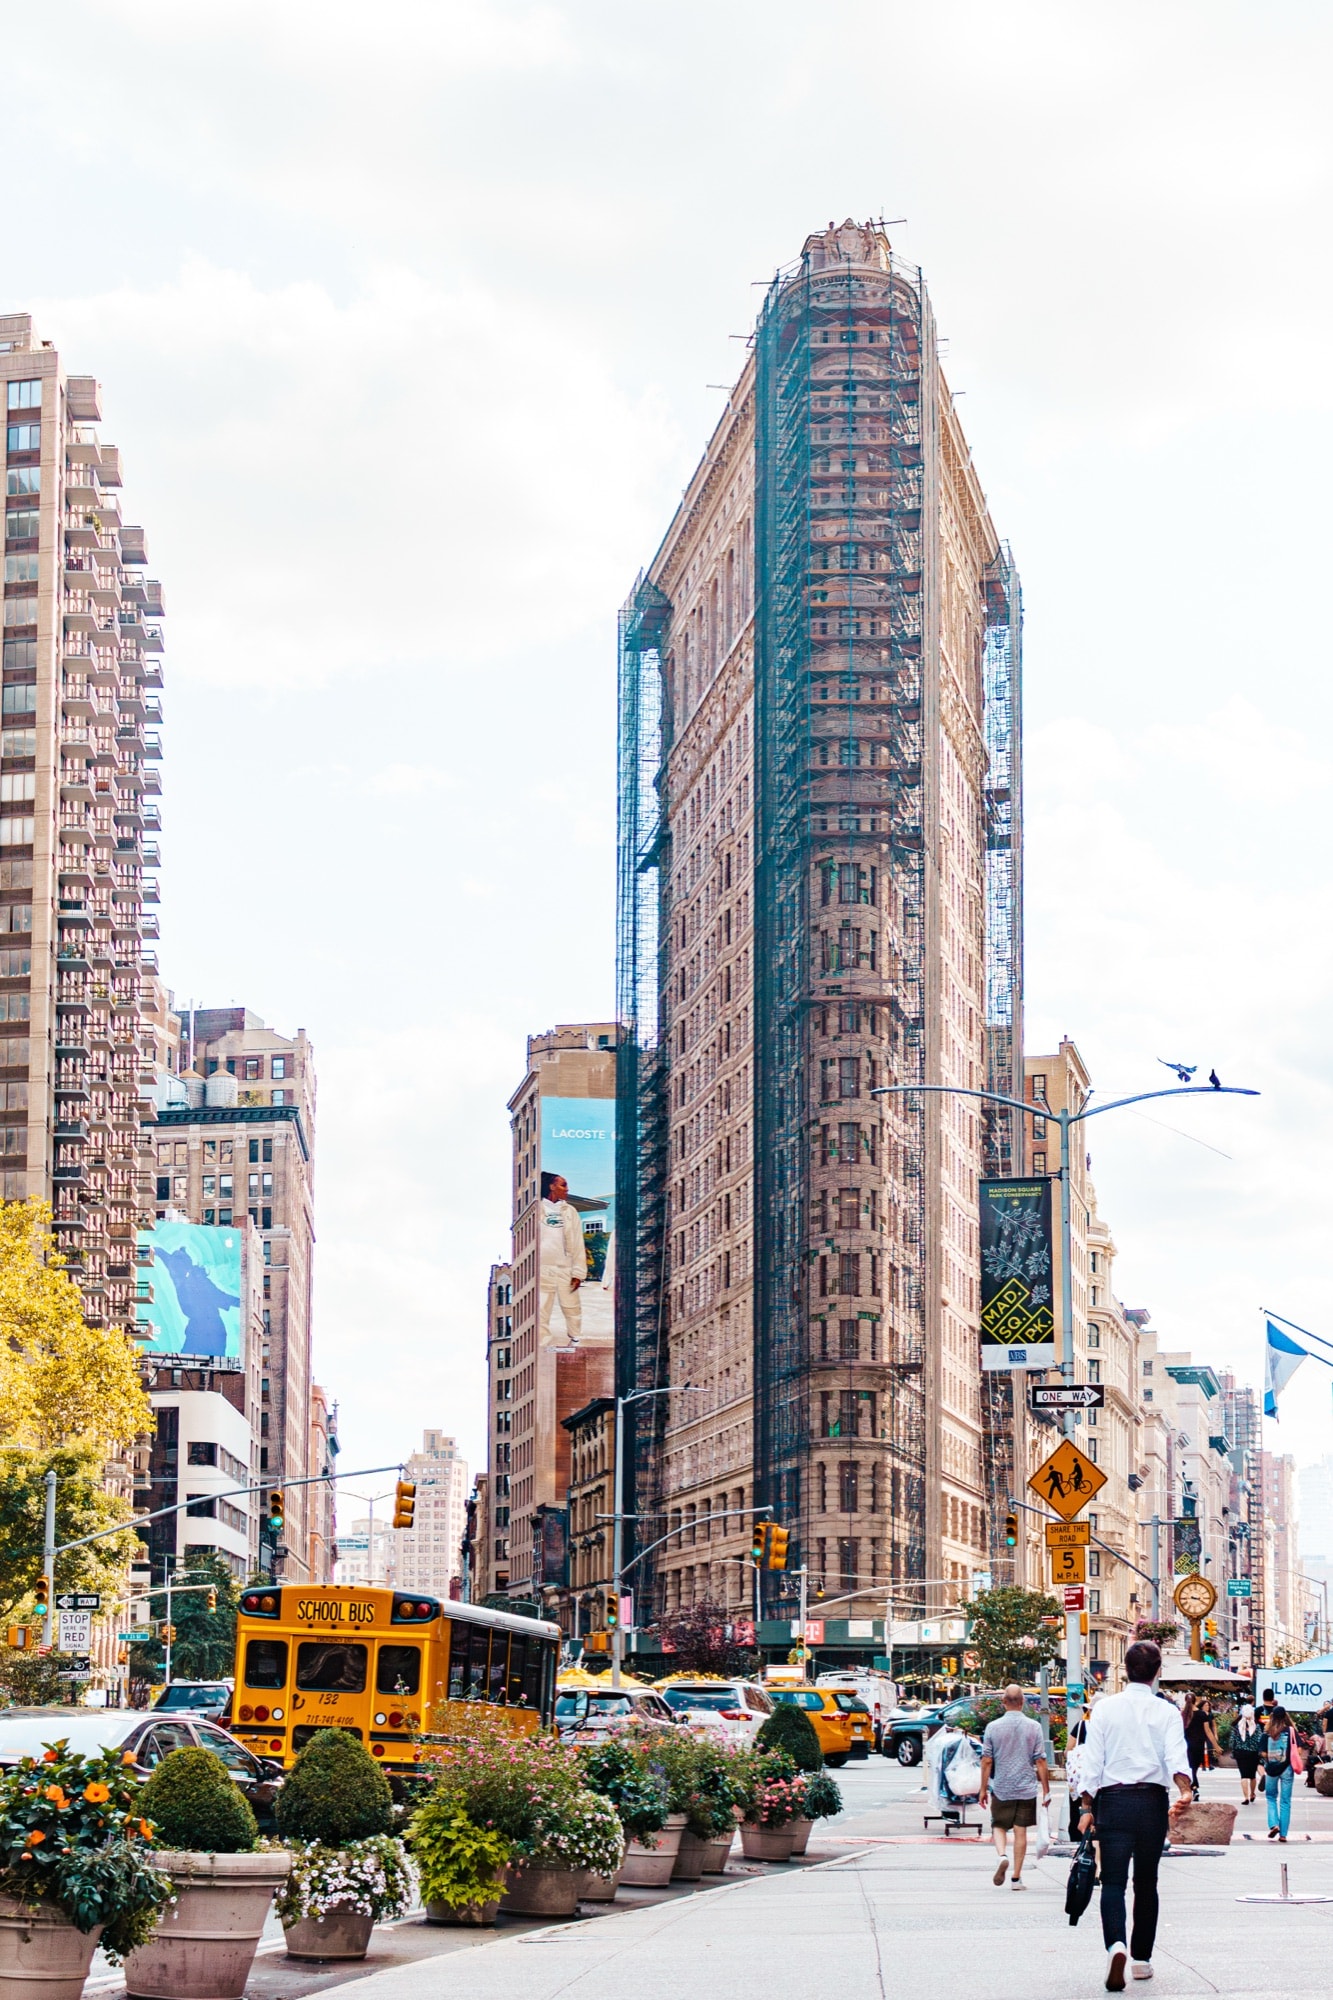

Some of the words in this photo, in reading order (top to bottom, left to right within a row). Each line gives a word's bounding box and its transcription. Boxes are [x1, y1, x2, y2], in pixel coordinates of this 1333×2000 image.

[552, 1128, 606, 1139] LACOSTE
[984, 1290, 1022, 1325] MAD.
[999, 1317, 1026, 1339] SQ.
[1025, 1318, 1052, 1341] PK.
[1042, 1392, 1063, 1401] ONE
[1072, 1392, 1093, 1401] WAY
[1063, 1552, 1074, 1569] 5
[297, 1601, 344, 1621] SCHOOL
[349, 1603, 374, 1623] BUS
[62, 1615, 88, 1624] STOP
[65, 1633, 85, 1641] RED
[1272, 1682, 1281, 1694] IL
[1285, 1682, 1322, 1696] PATIO
[319, 1693, 339, 1705] 132
[306, 1714, 354, 1725] 718-748-4100
